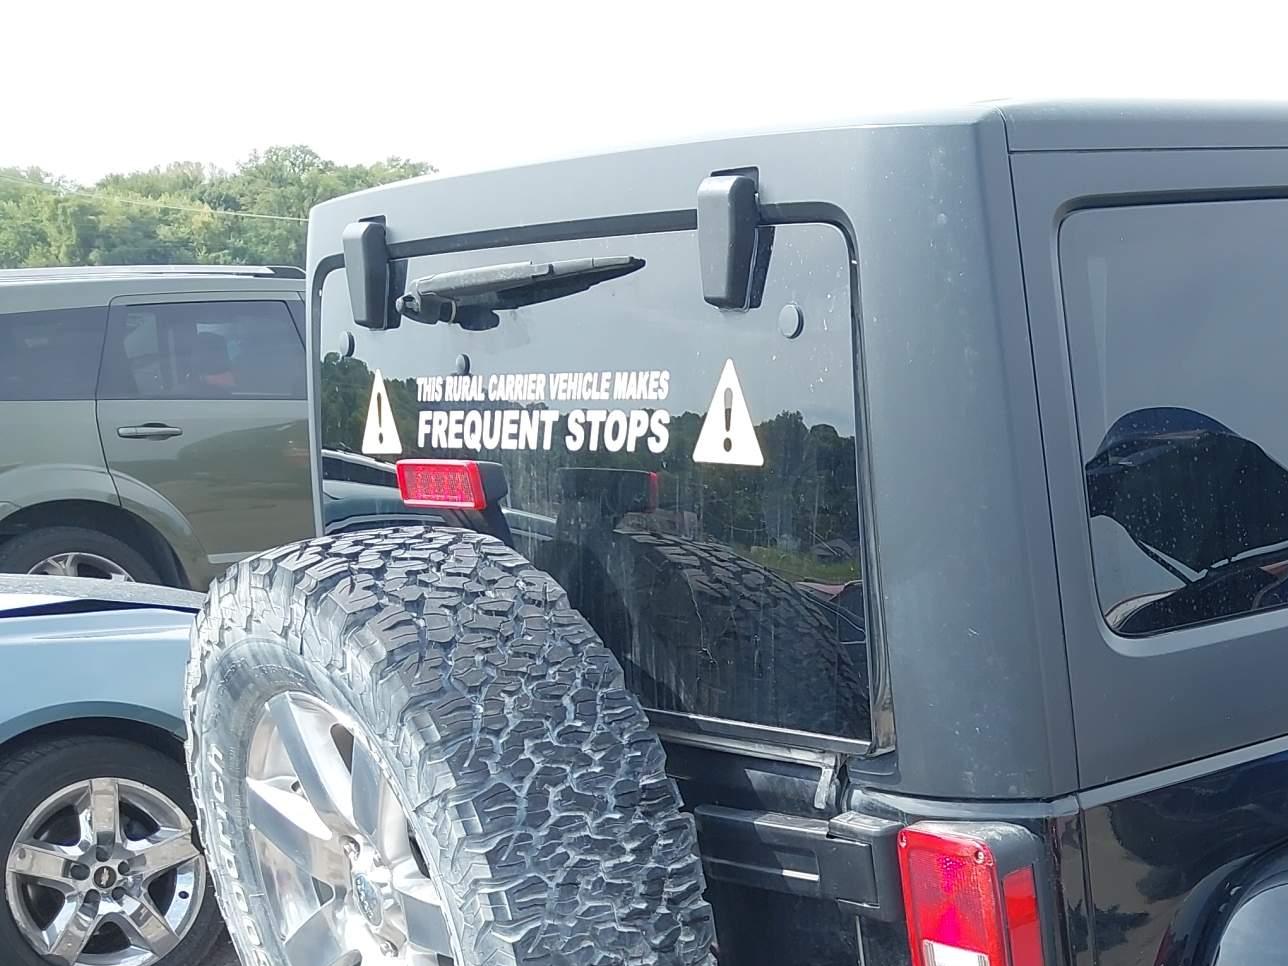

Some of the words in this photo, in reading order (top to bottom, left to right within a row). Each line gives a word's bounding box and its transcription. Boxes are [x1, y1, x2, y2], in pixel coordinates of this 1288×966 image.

[416, 376, 443, 402] THIS
[444, 375, 486, 402] RURAL
[488, 374, 547, 402] CARRIER
[549, 372, 613, 401] VEHICLE
[613, 370, 670, 400] MAKES
[417, 410, 560, 452] FREQUENT
[565, 408, 671, 454] STOPS
